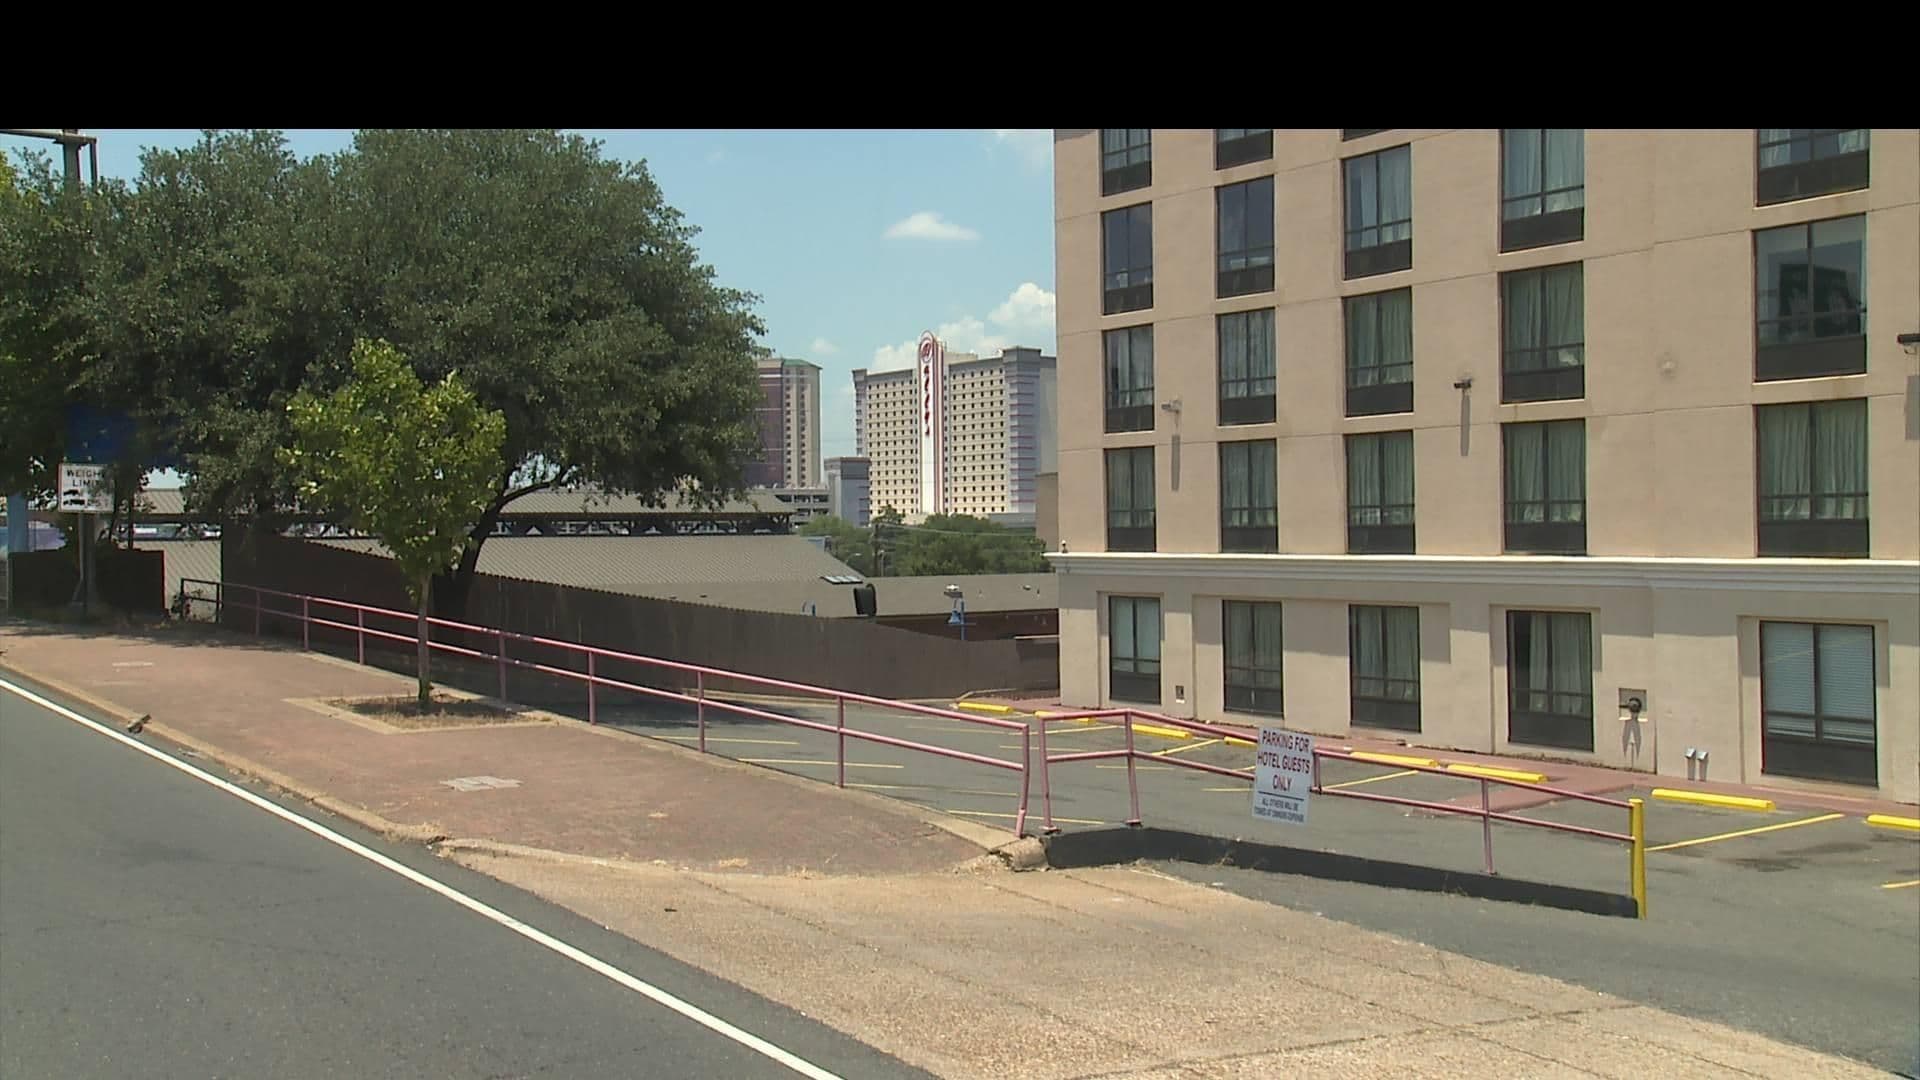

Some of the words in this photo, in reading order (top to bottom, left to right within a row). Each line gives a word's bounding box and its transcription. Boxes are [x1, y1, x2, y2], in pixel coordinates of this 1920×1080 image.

[1262, 730, 1293, 750] PARKING
[1294, 736, 1310, 753] FOR
[1257, 751, 1280, 768] HOTEL
[1282, 755, 1310, 774] GUESTS
[1272, 774, 1292, 791] ONLY
